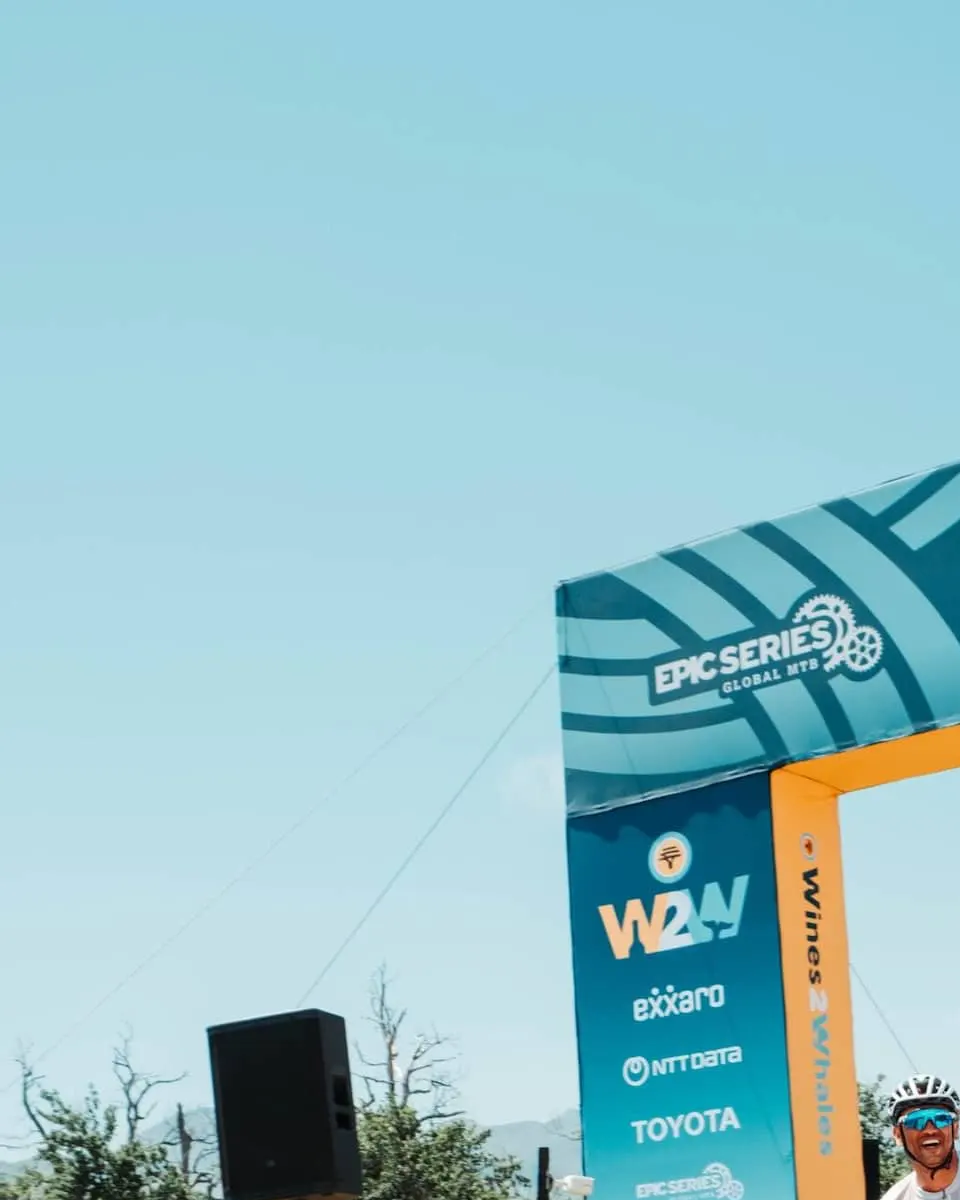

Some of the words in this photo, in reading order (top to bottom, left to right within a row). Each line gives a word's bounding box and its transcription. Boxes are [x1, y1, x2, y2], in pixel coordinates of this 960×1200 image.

[654, 652, 717, 695] EPIC
[718, 619, 833, 675] SERIES
[722, 671, 782, 694] GLOBAL
[787, 658, 820, 677] MTB
[598, 875, 750, 960] W2W
[630, 1107, 741, 1144] TOYOTA
